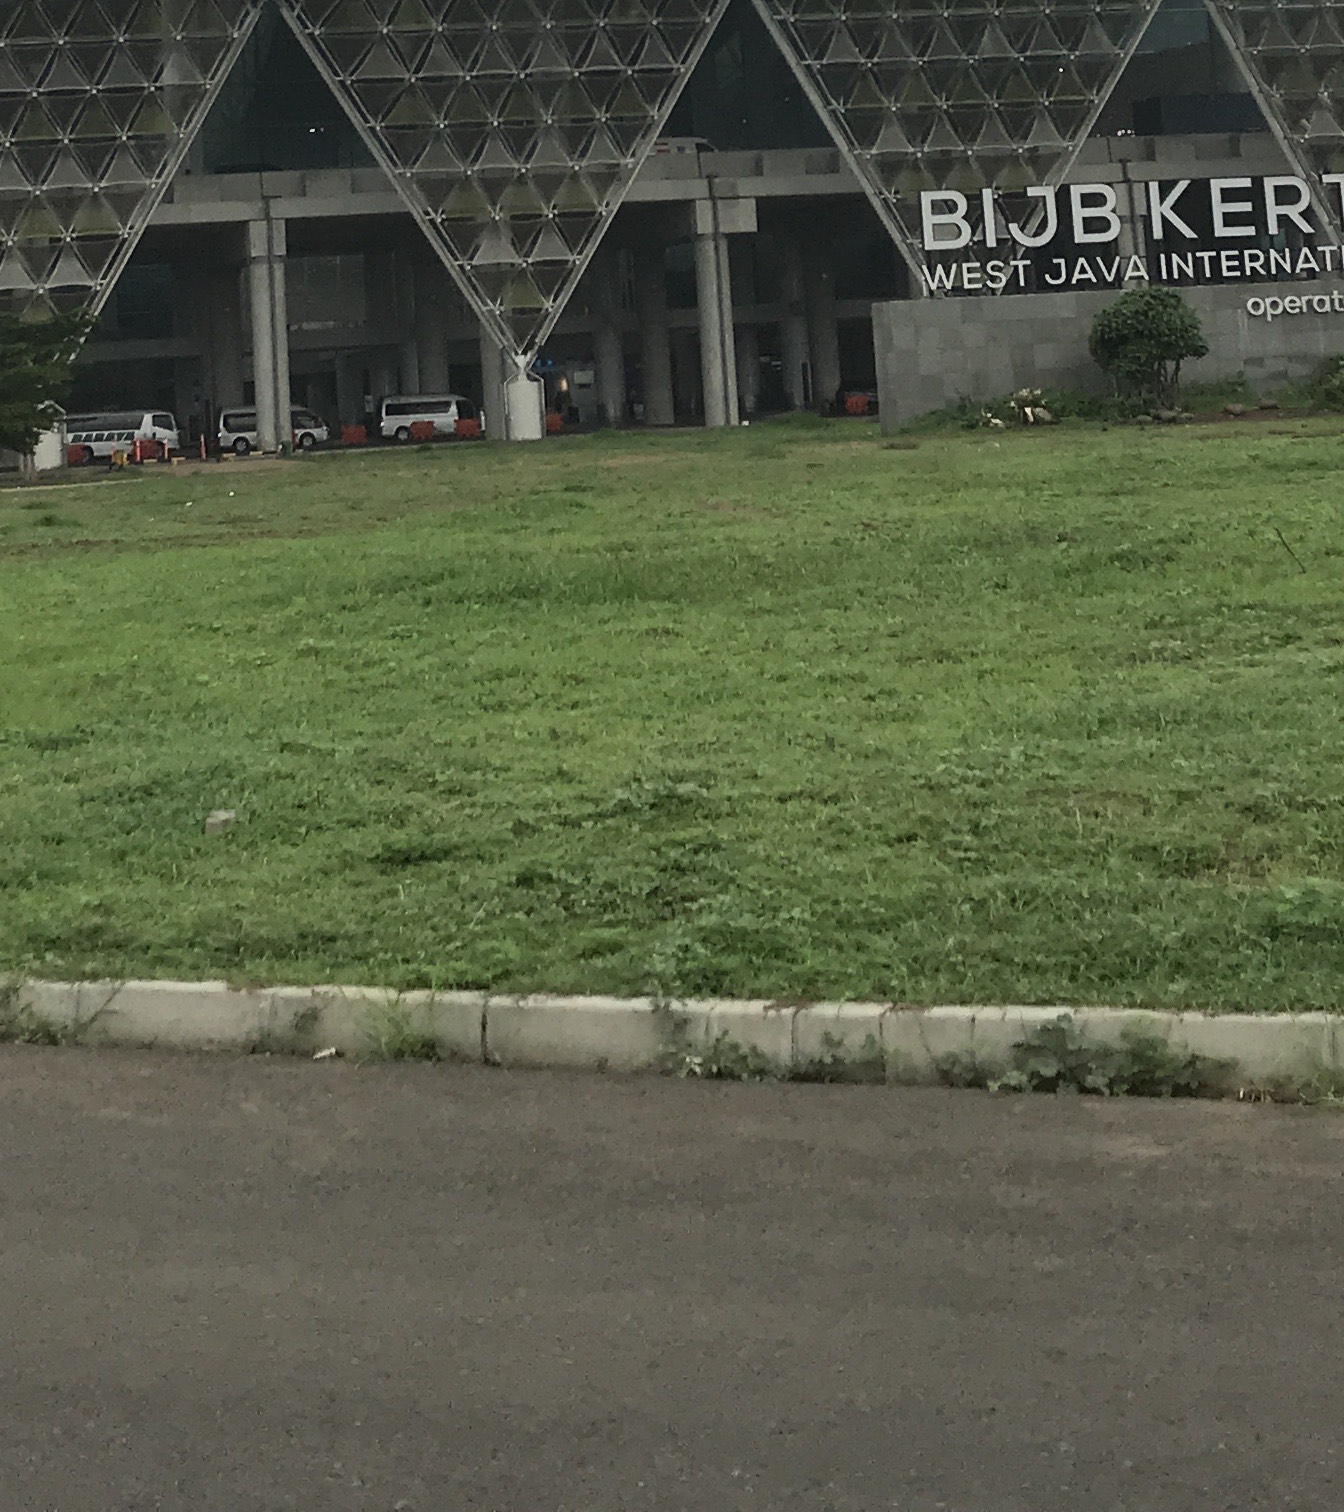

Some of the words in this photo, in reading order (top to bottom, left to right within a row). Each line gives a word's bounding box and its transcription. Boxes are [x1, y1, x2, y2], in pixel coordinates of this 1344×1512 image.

[920, 183, 1119, 251] BIJB
[922, 260, 1032, 290] WEST
[1044, 254, 1149, 285] JAVA
